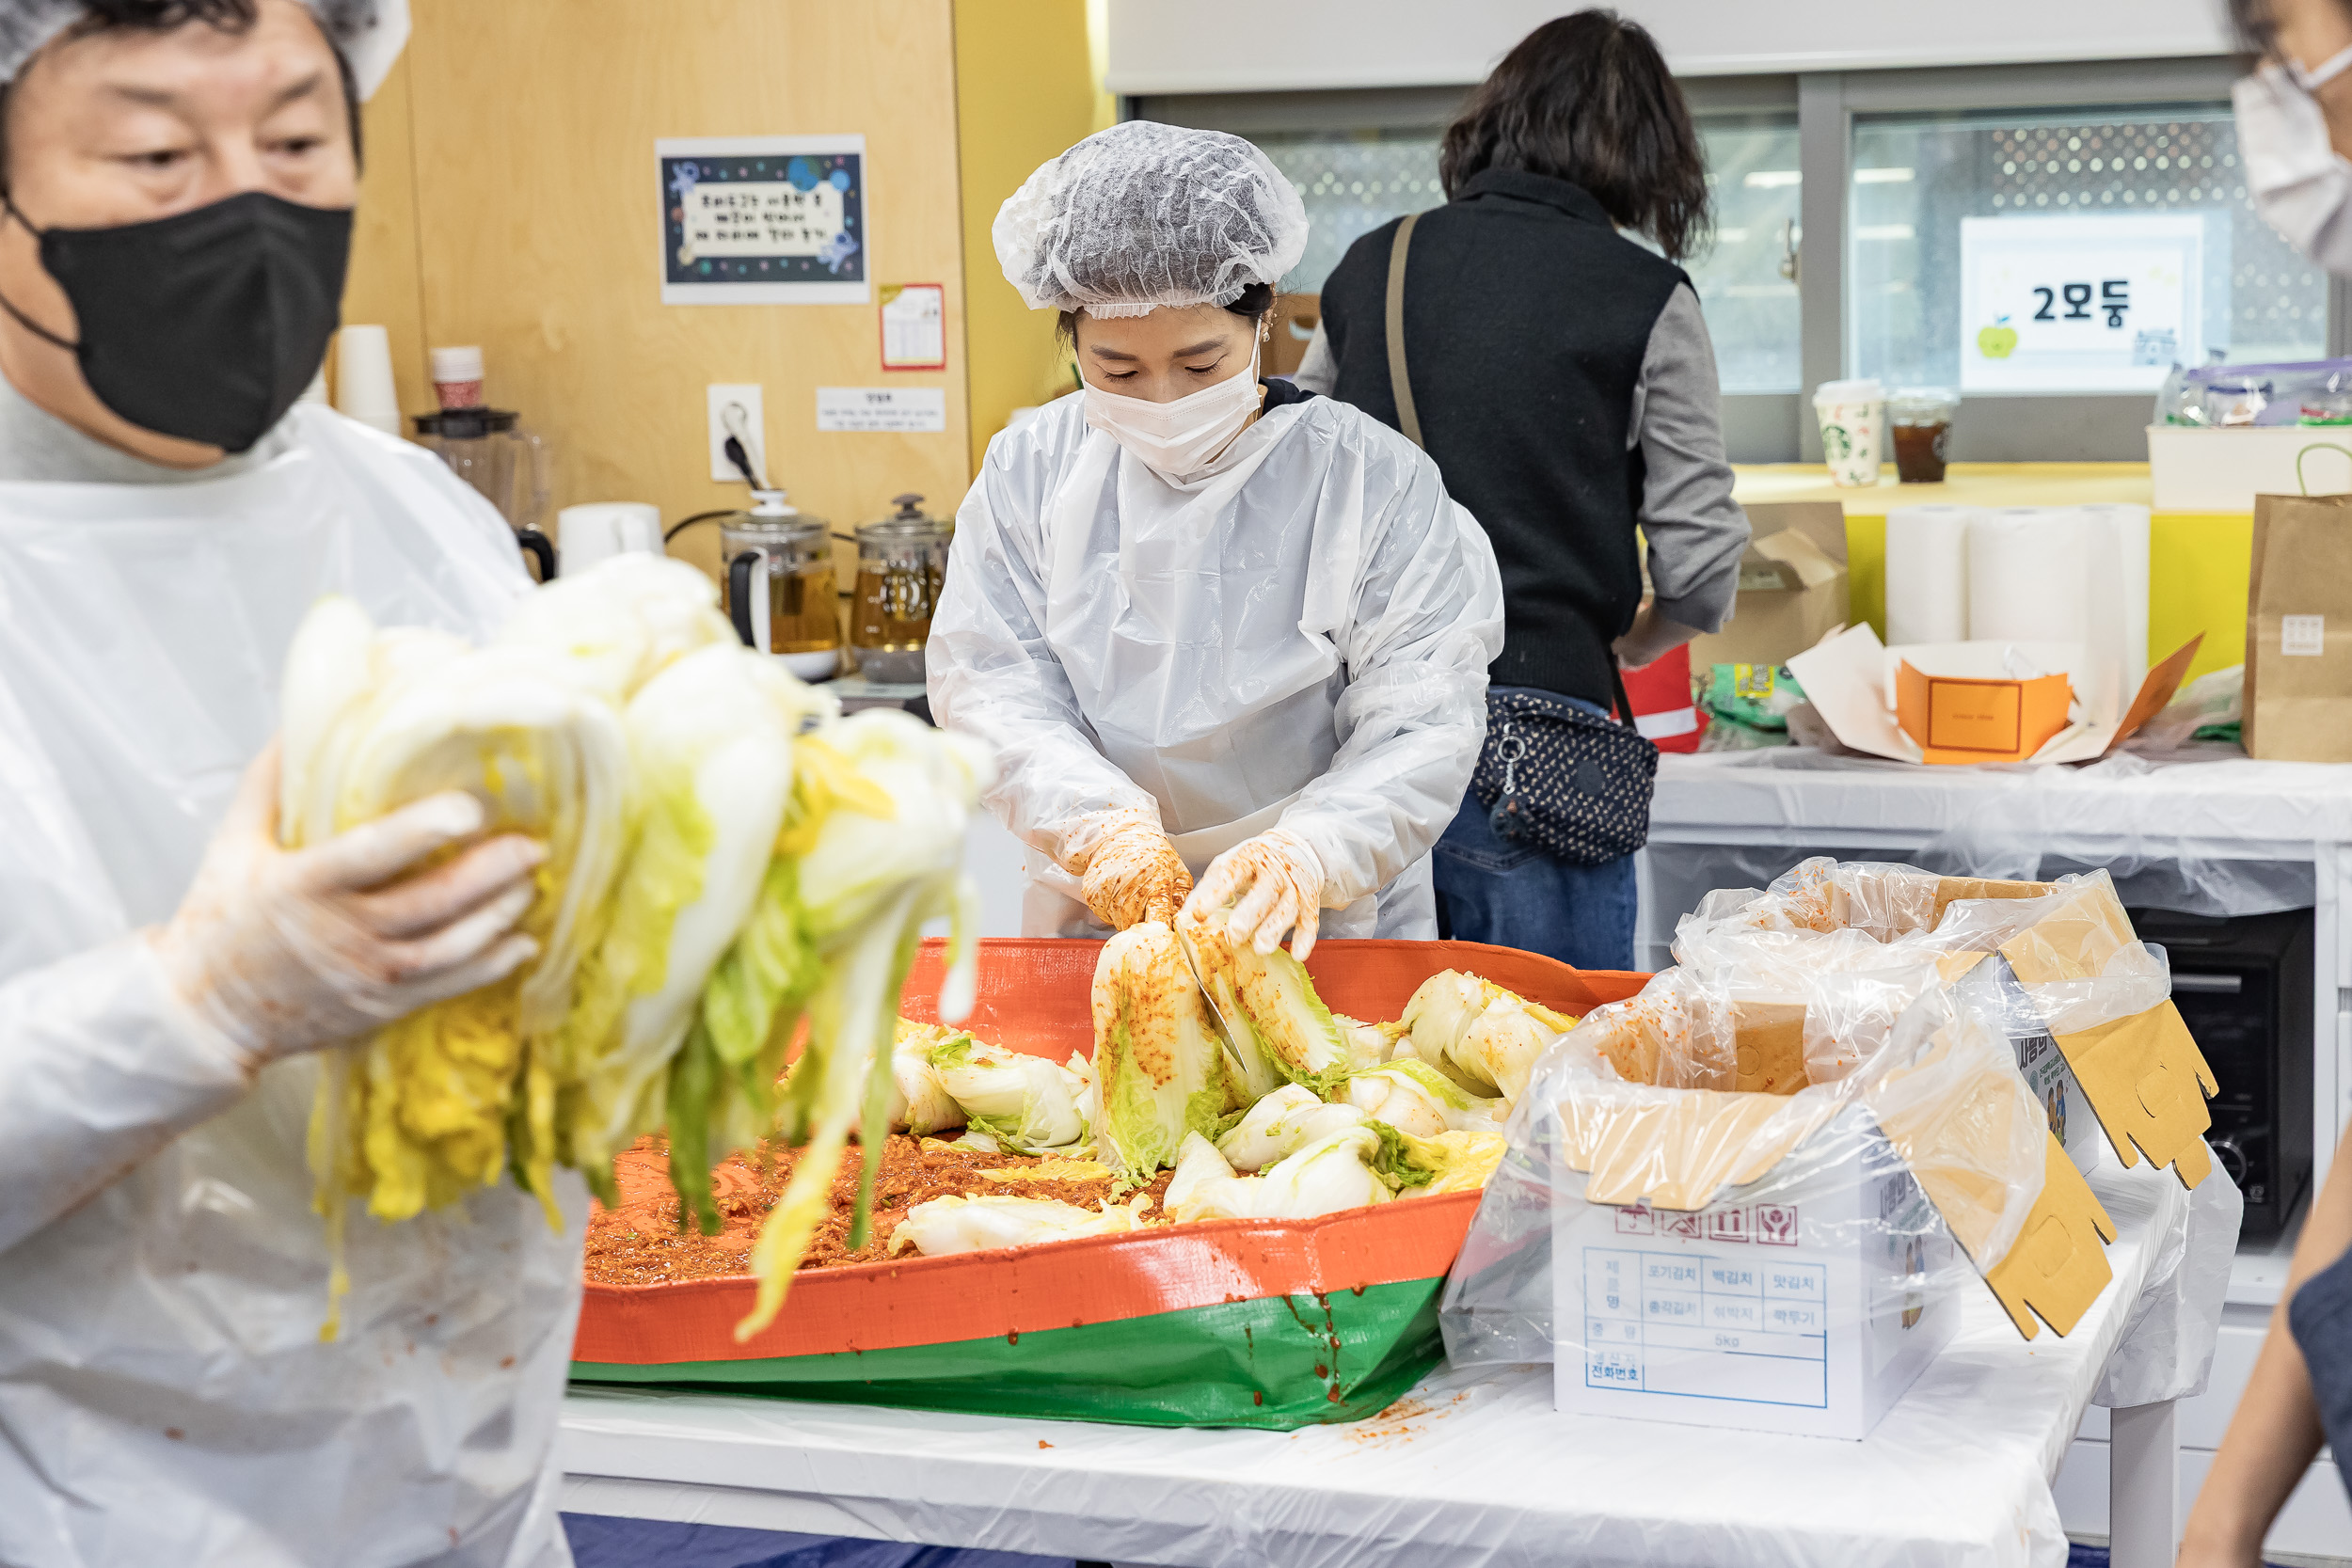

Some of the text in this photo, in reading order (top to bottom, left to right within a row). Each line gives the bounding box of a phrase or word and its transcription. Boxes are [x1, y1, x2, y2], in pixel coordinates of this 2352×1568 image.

[2033, 280, 2130, 327] 2모둠
[1648, 1265, 1696, 1281] 포기김치
[1712, 1270, 1753, 1286] 백김치
[1773, 1274, 1815, 1291] 맛김치
[1649, 1300, 1696, 1317] 총각김치
[1773, 1309, 1815, 1325] 깍두기
[1592, 1364, 1638, 1381] 전화번호
